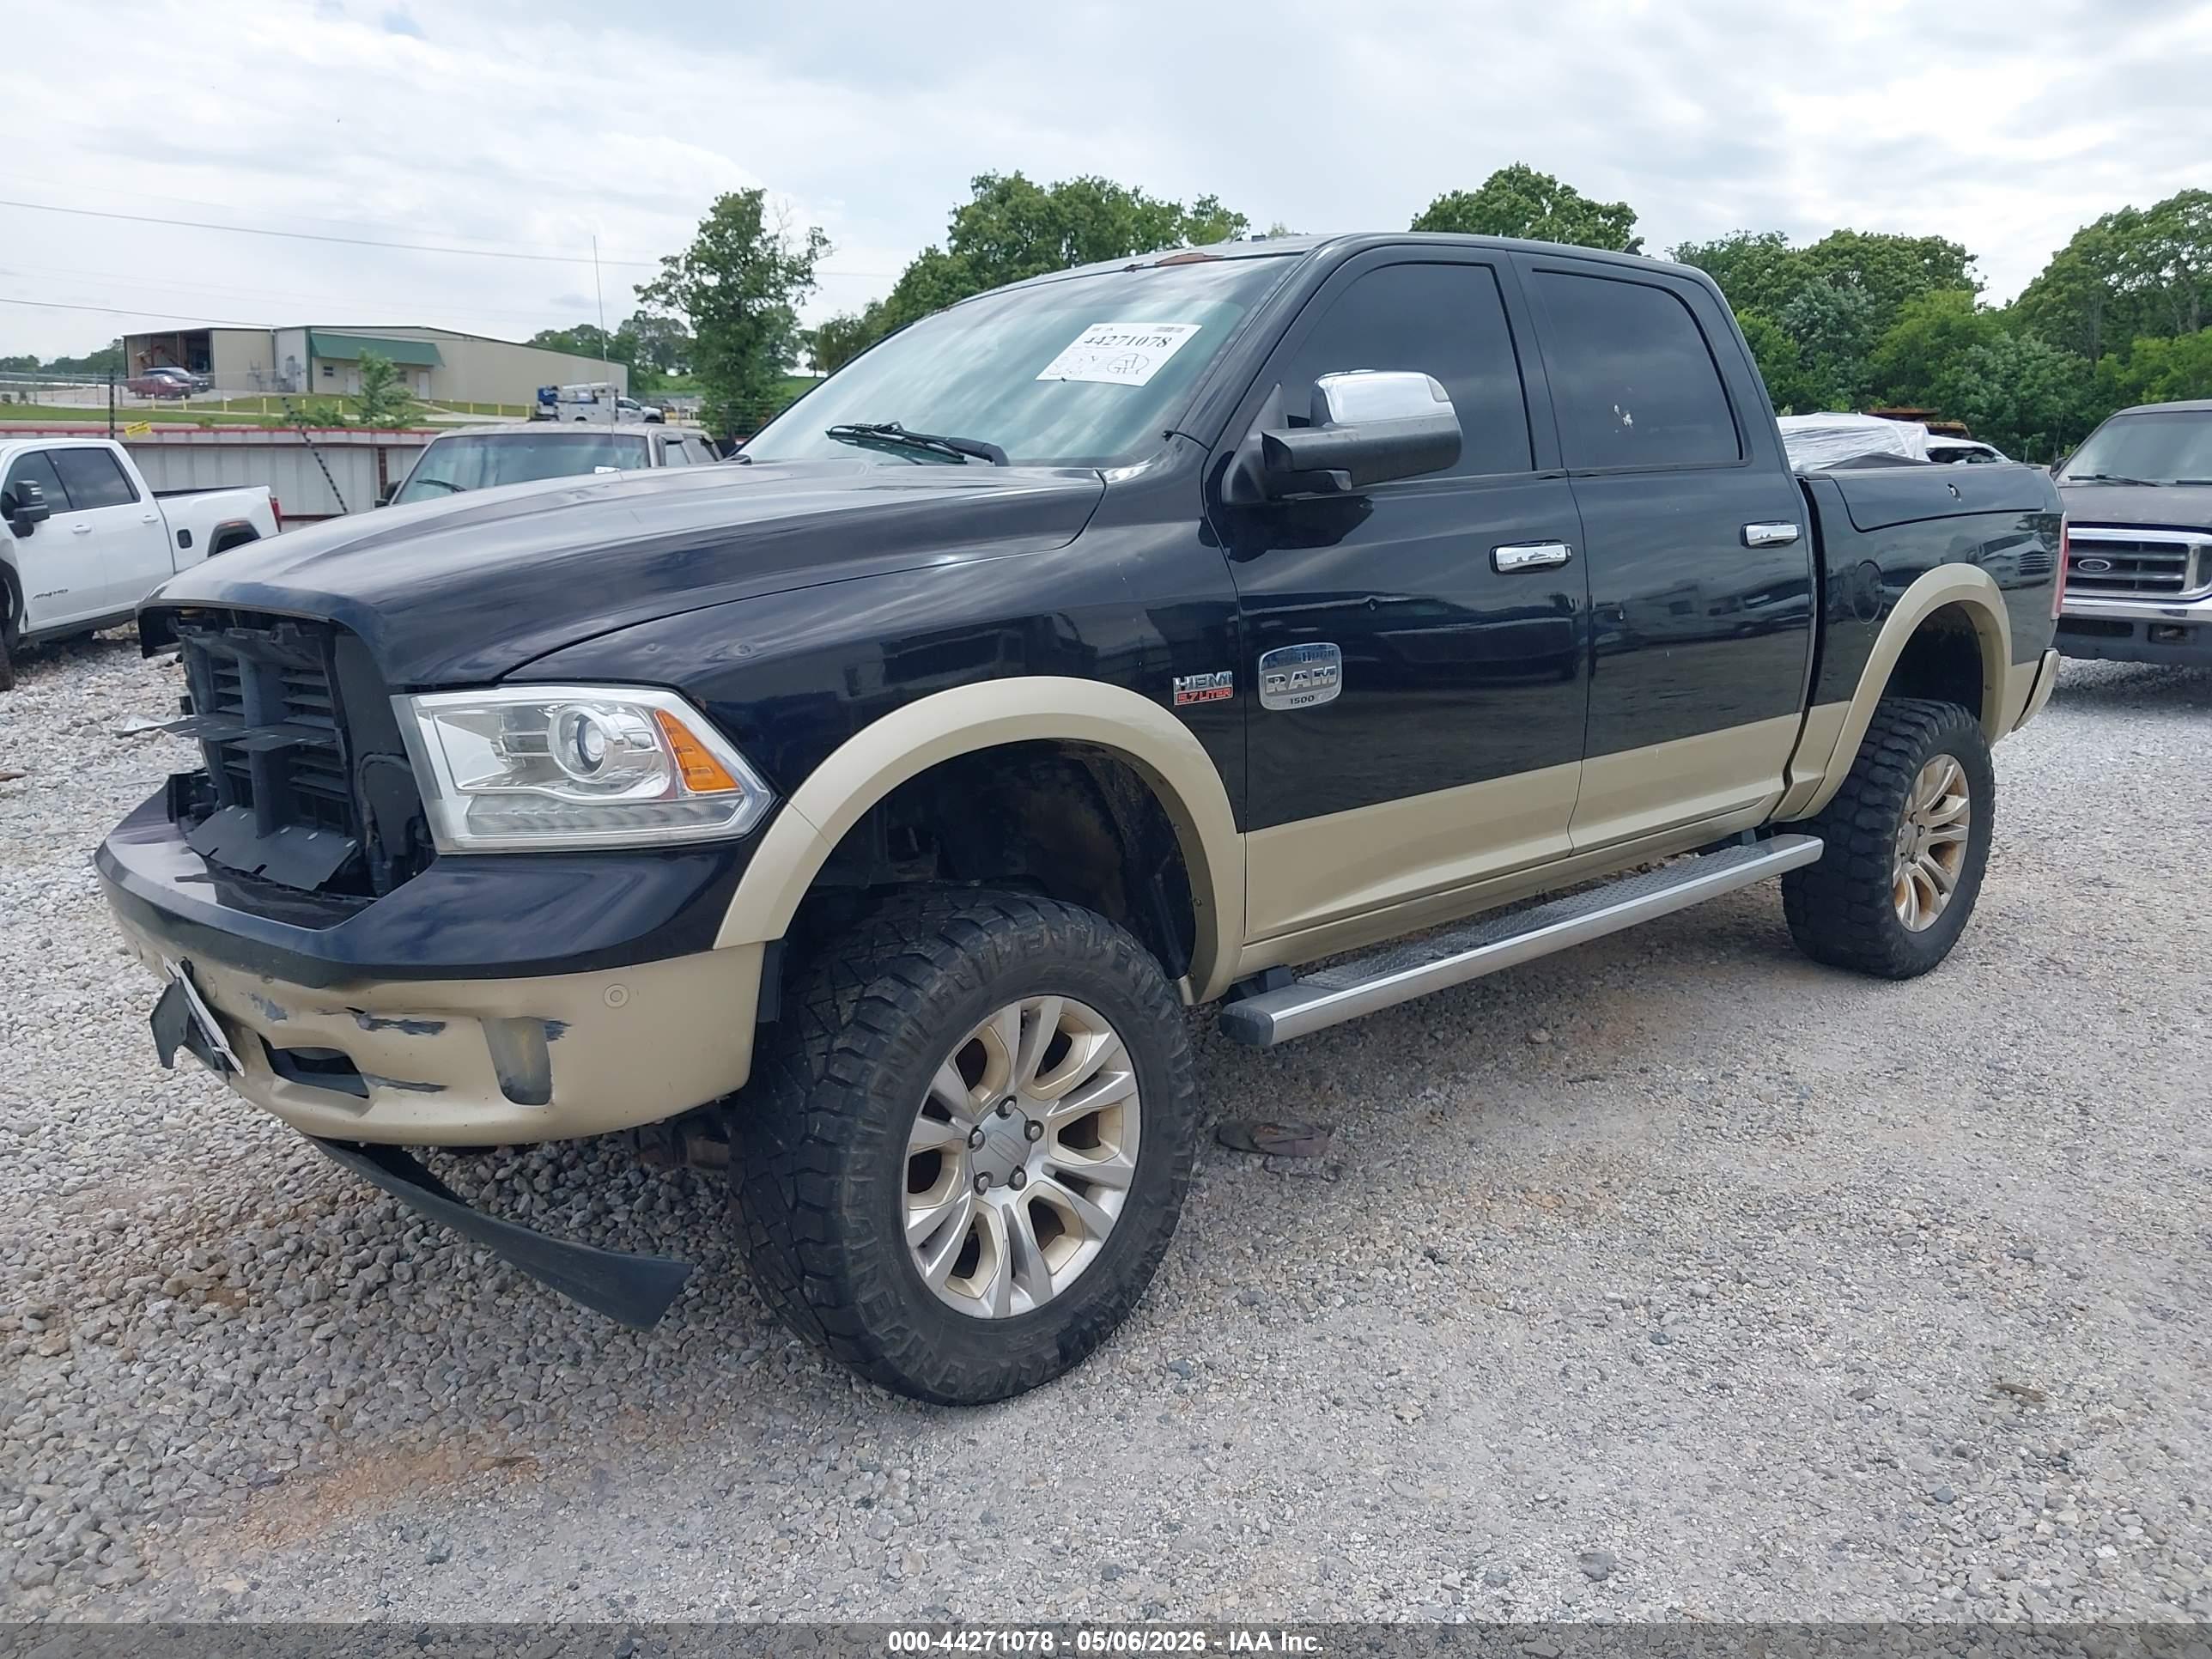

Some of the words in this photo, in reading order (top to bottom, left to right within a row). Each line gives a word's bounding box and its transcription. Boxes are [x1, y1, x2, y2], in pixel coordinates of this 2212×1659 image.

[1083, 335, 1173, 348] 44271078
[1172, 671, 1232, 693] HEMI
[1266, 665, 1337, 694] RAM
[1178, 691, 1198, 703] 5.7
[1199, 688, 1231, 701] LITER
[1291, 695, 1315, 705] 1500
